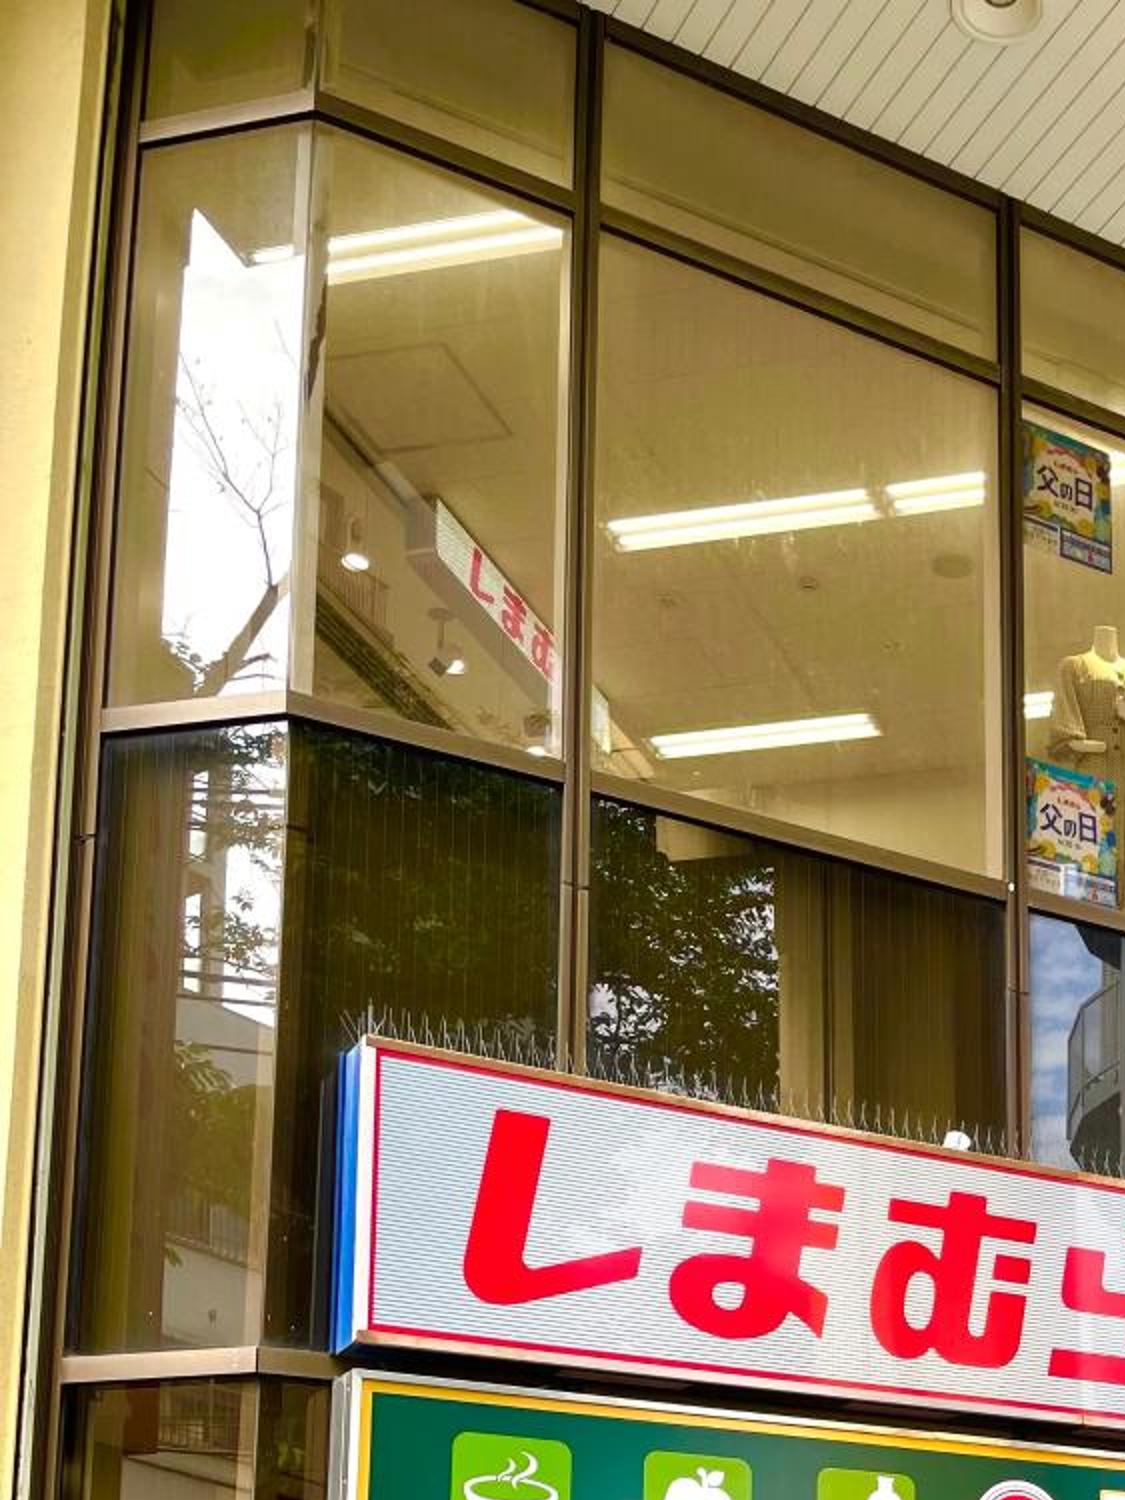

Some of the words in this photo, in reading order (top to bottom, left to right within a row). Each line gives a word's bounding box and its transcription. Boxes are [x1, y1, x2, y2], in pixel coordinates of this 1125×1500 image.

[1036, 464, 1093, 511] 父の日
[1039, 802, 1097, 844] 父の日
